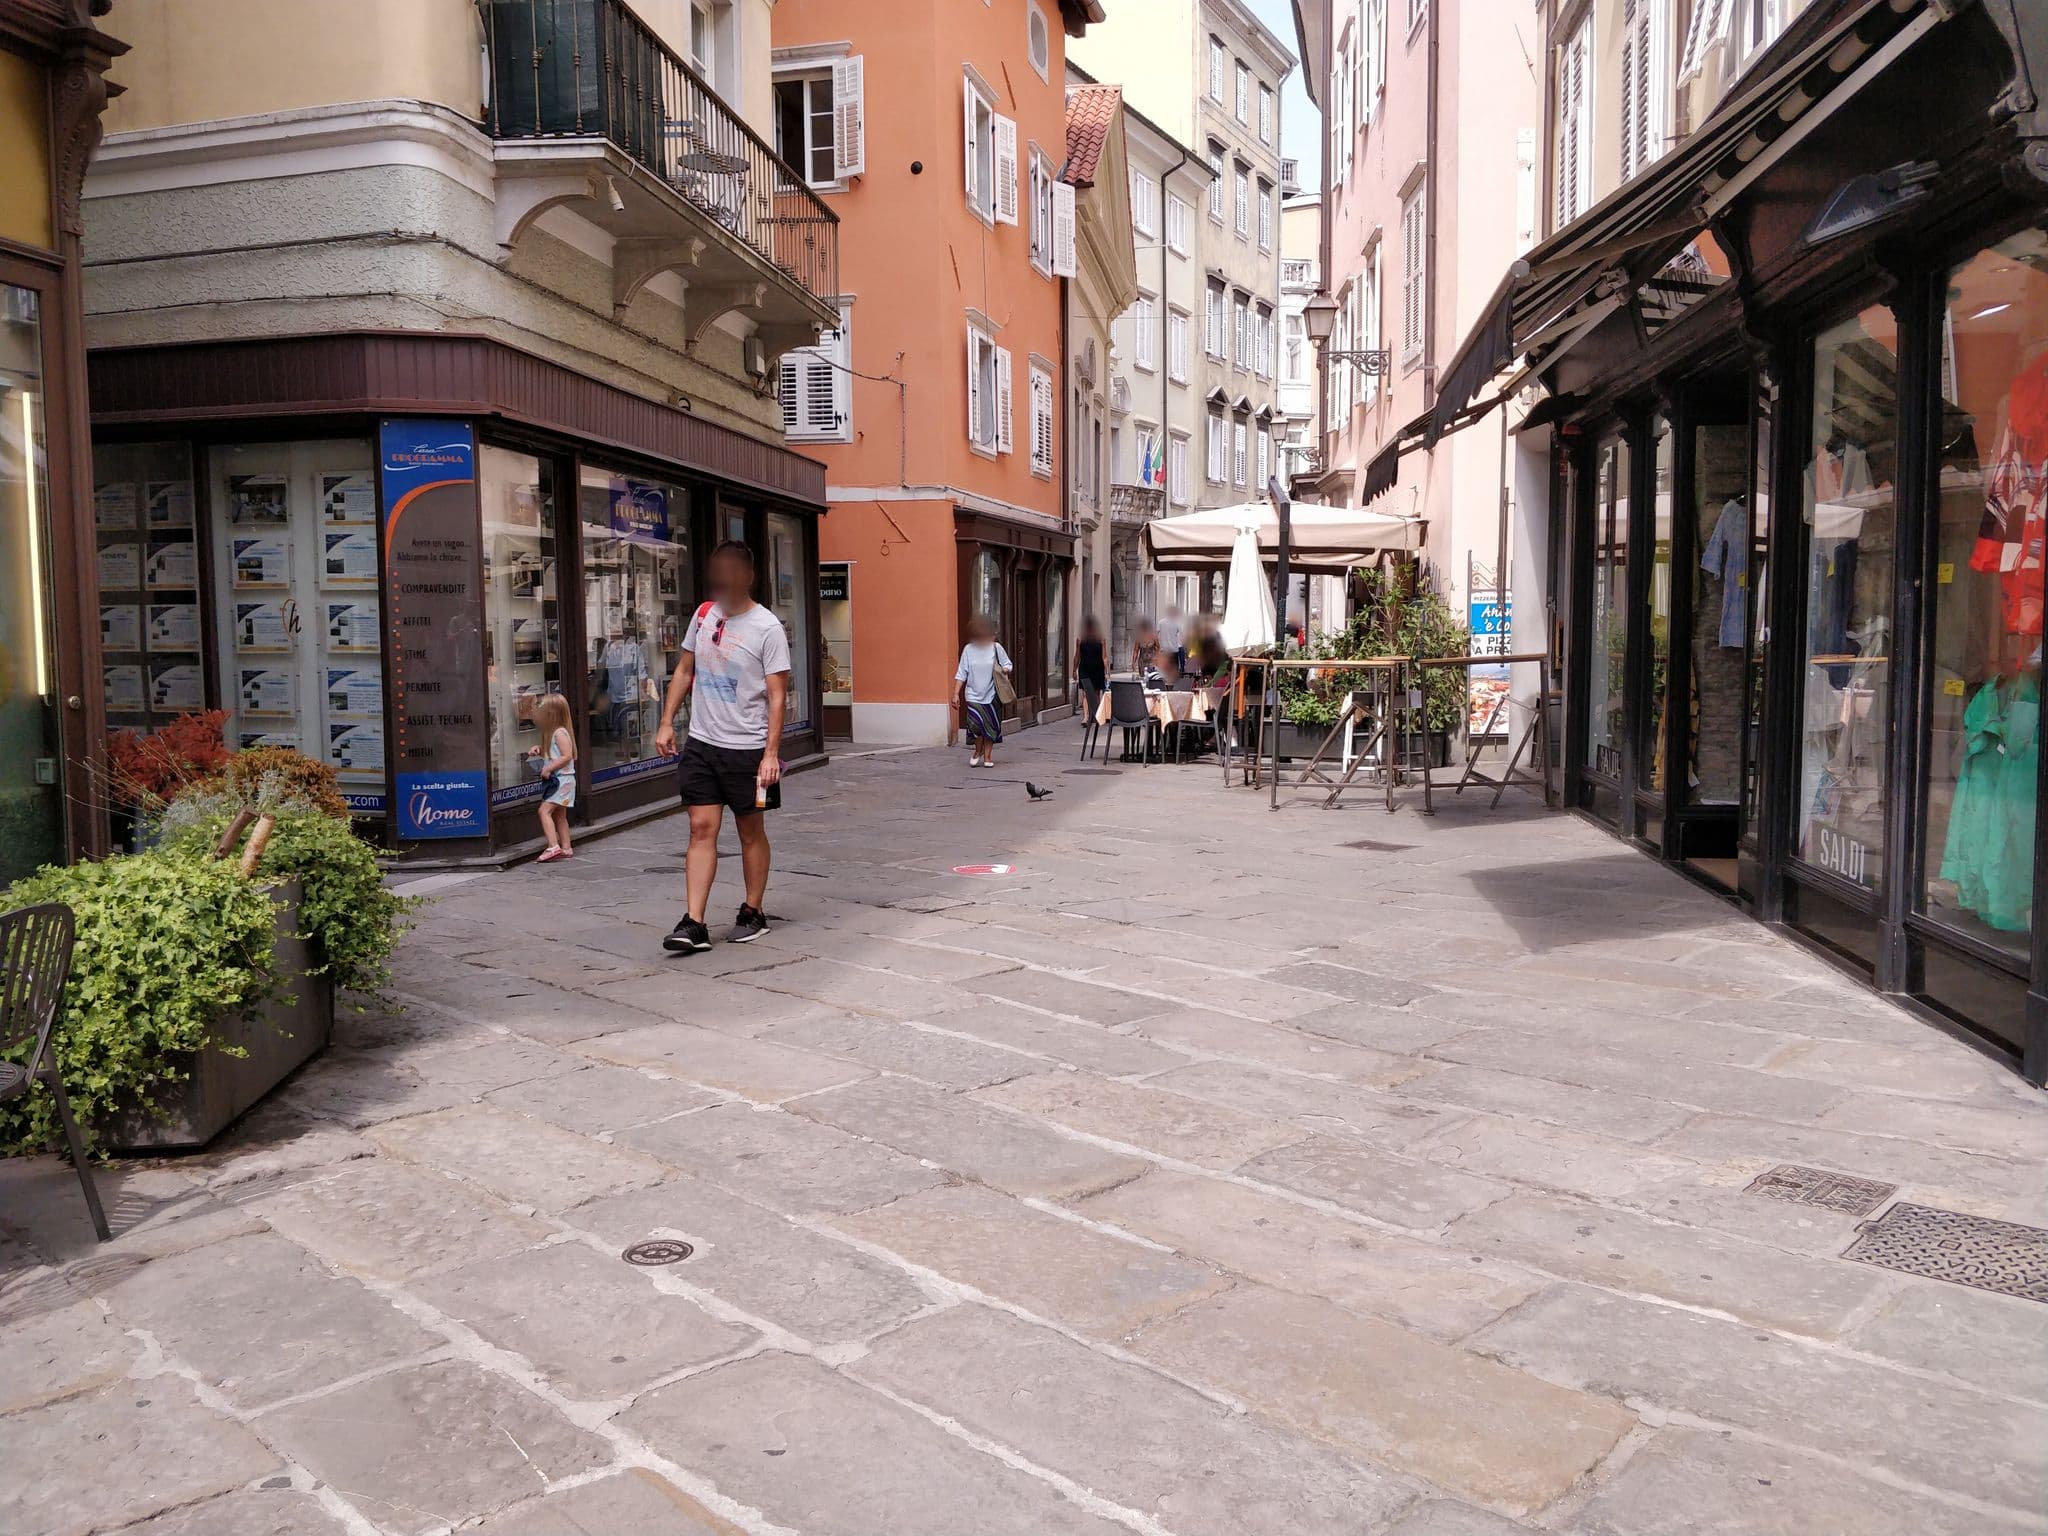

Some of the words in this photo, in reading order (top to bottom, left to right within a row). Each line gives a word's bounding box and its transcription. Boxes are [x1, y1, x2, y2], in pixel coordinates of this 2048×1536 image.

[401, 583, 466, 594] COMPRAVENDITE
[820, 588, 842, 598] pano
[403, 616, 431, 626] AFFITTI
[1487, 635, 1512, 645] PIZZ
[404, 649, 427, 660] STIME
[406, 682, 441, 693] PERMUTE
[438, 714, 473, 725] TECNICA
[423, 782, 445, 790] scelta
[418, 795, 474, 825] home
[1820, 828, 1865, 884] SALDI
[1947, 1260, 2042, 1285] ACQUA
